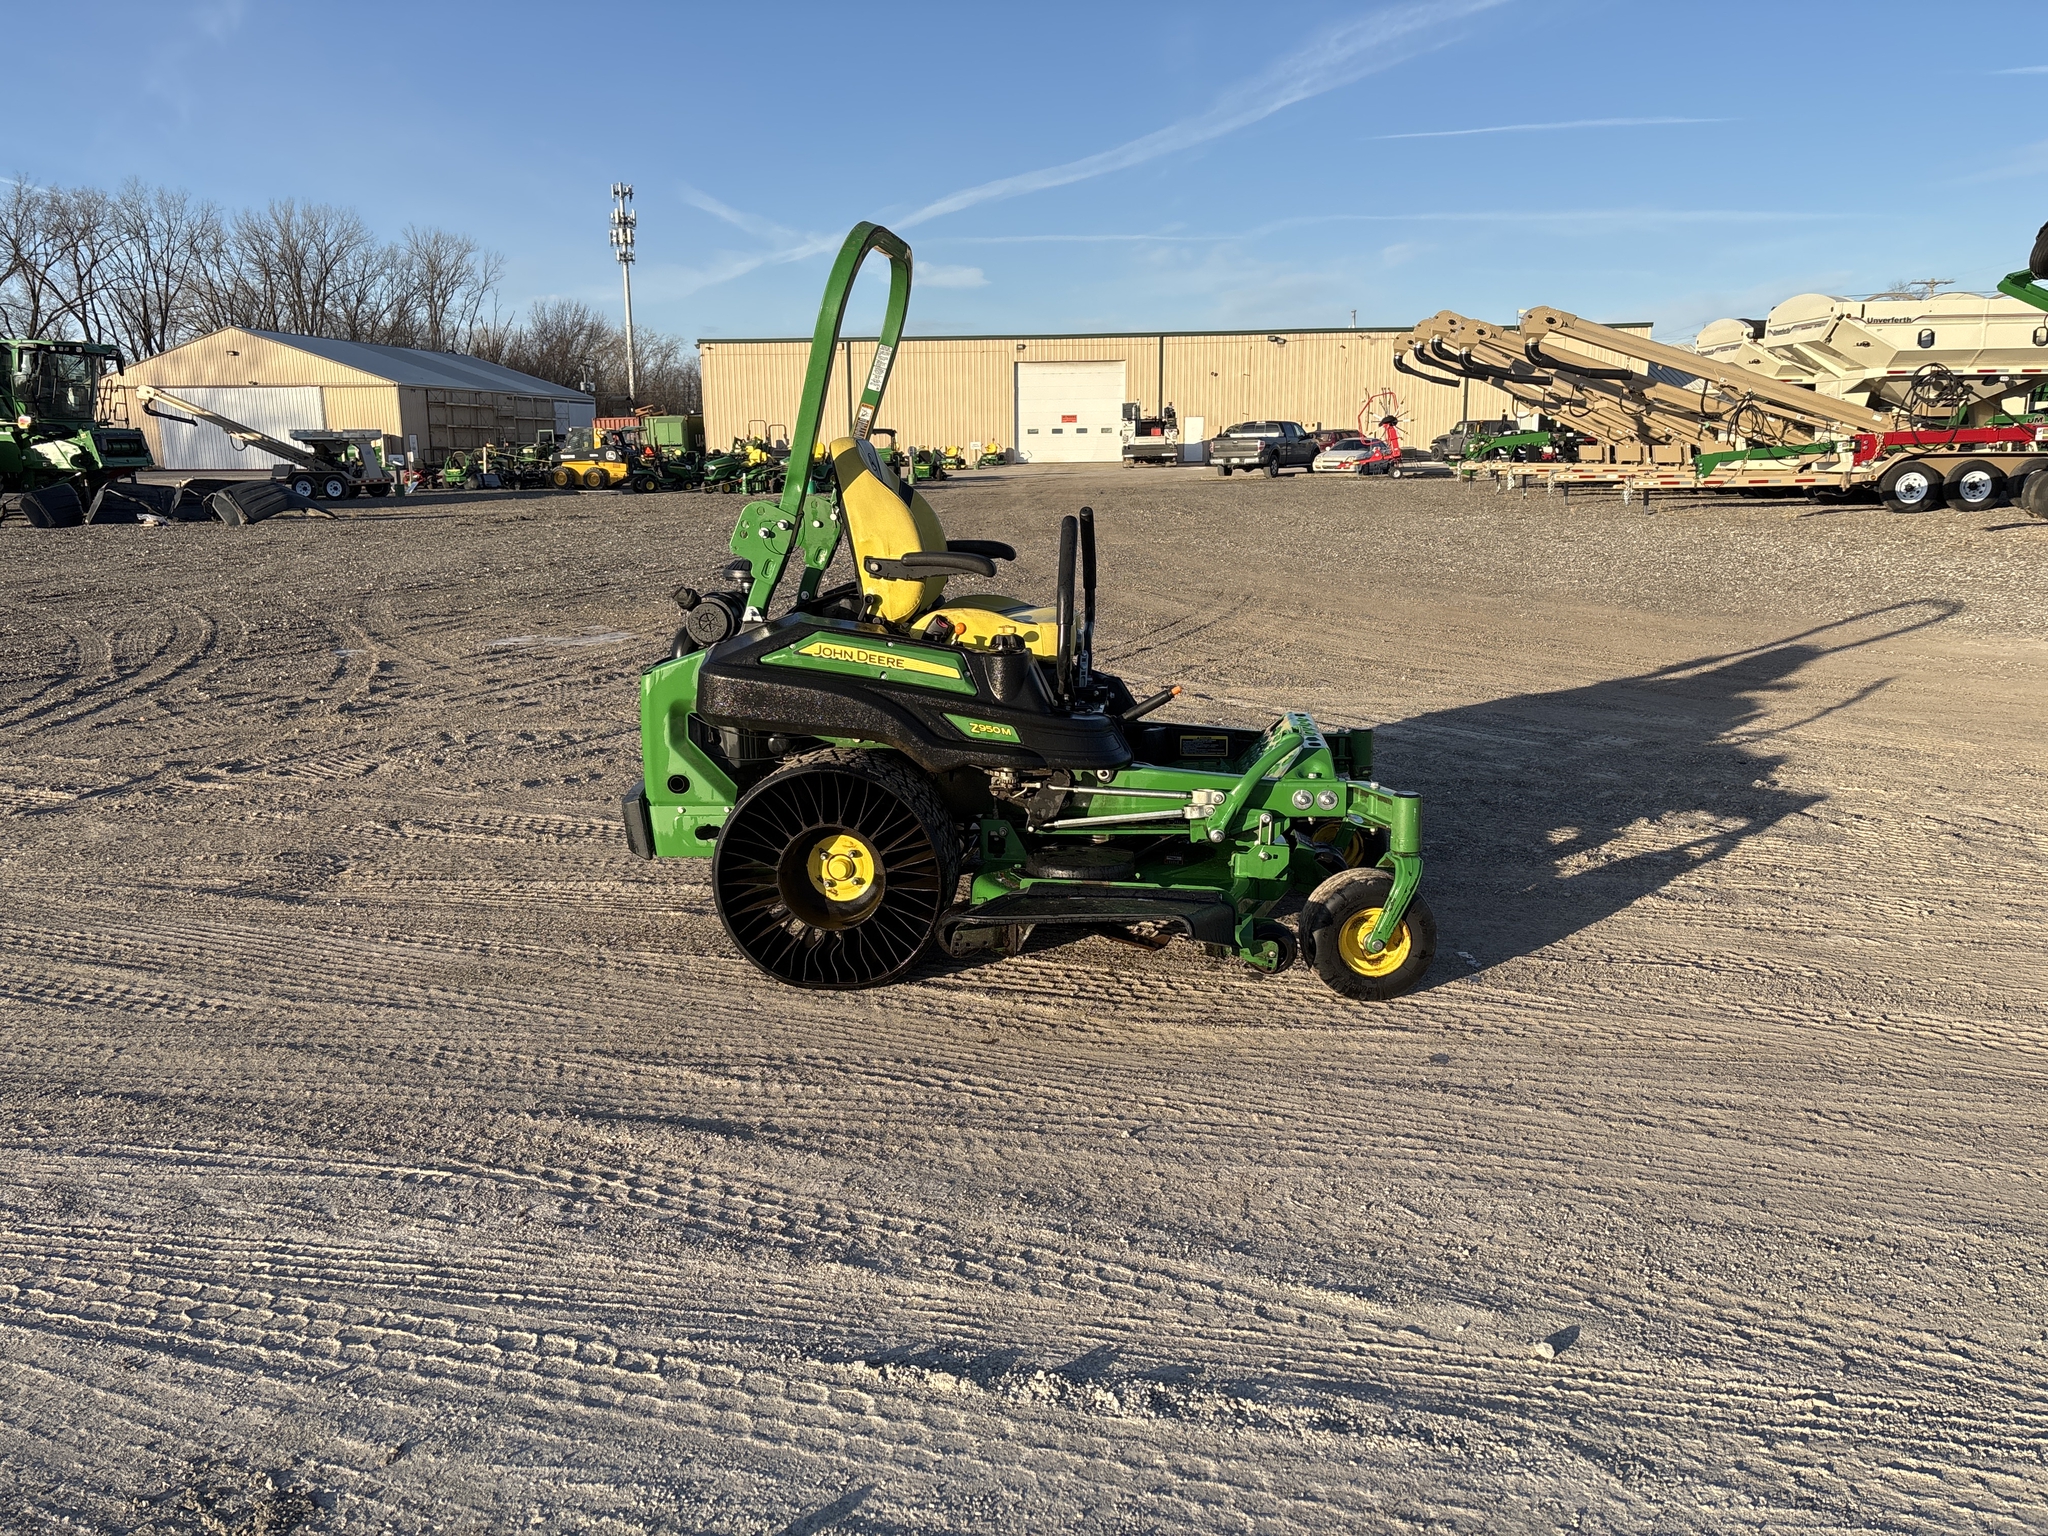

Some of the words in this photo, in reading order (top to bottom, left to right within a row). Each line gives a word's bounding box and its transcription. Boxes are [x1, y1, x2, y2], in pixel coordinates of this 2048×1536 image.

[2027, 416, 2044, 424] UM
[814, 645, 853, 660] JOHN
[857, 651, 905, 668] DEERE
[969, 723, 1012, 736] Z950M
